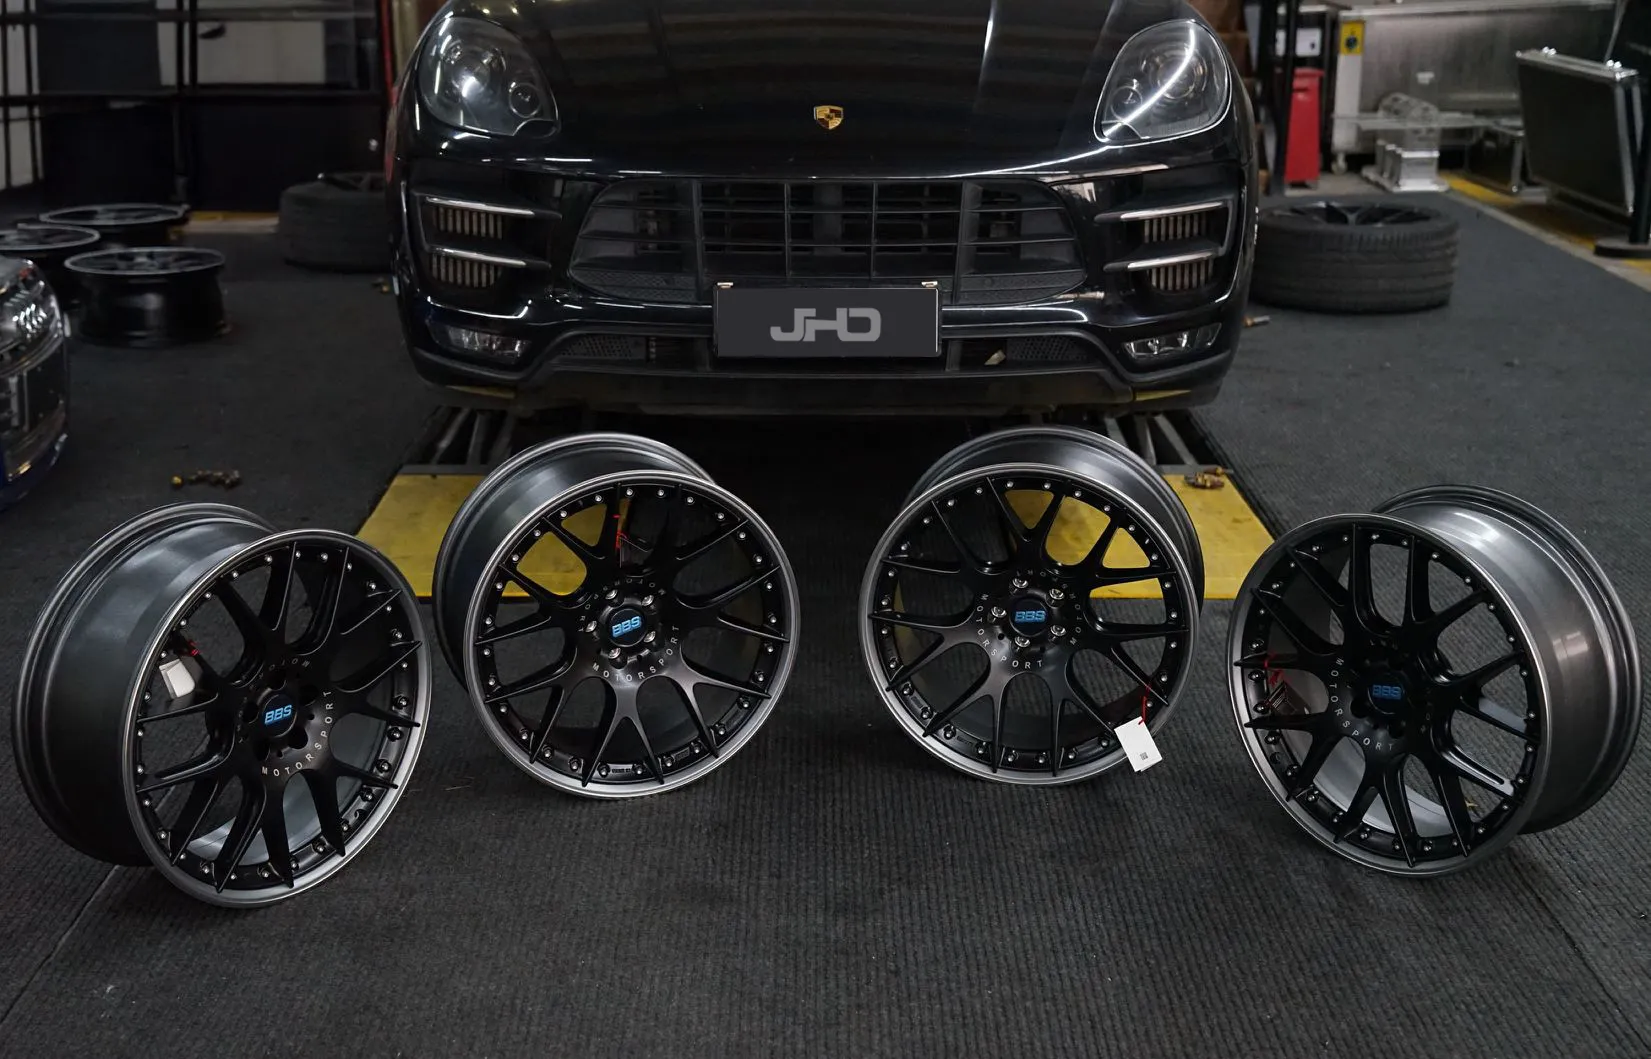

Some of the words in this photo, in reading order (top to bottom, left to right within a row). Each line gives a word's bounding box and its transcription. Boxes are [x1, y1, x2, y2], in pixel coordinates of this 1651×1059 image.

[611, 615, 642, 638] BBS
[975, 593, 1043, 669] MOTORSPORT
[1014, 609, 1047, 624] BBS
[592, 625, 680, 681] MOTORSPORT
[264, 704, 293, 726] BBS
[1329, 656, 1395, 751] MOTORSPORT
[261, 690, 334, 777] MOTORSPORT
